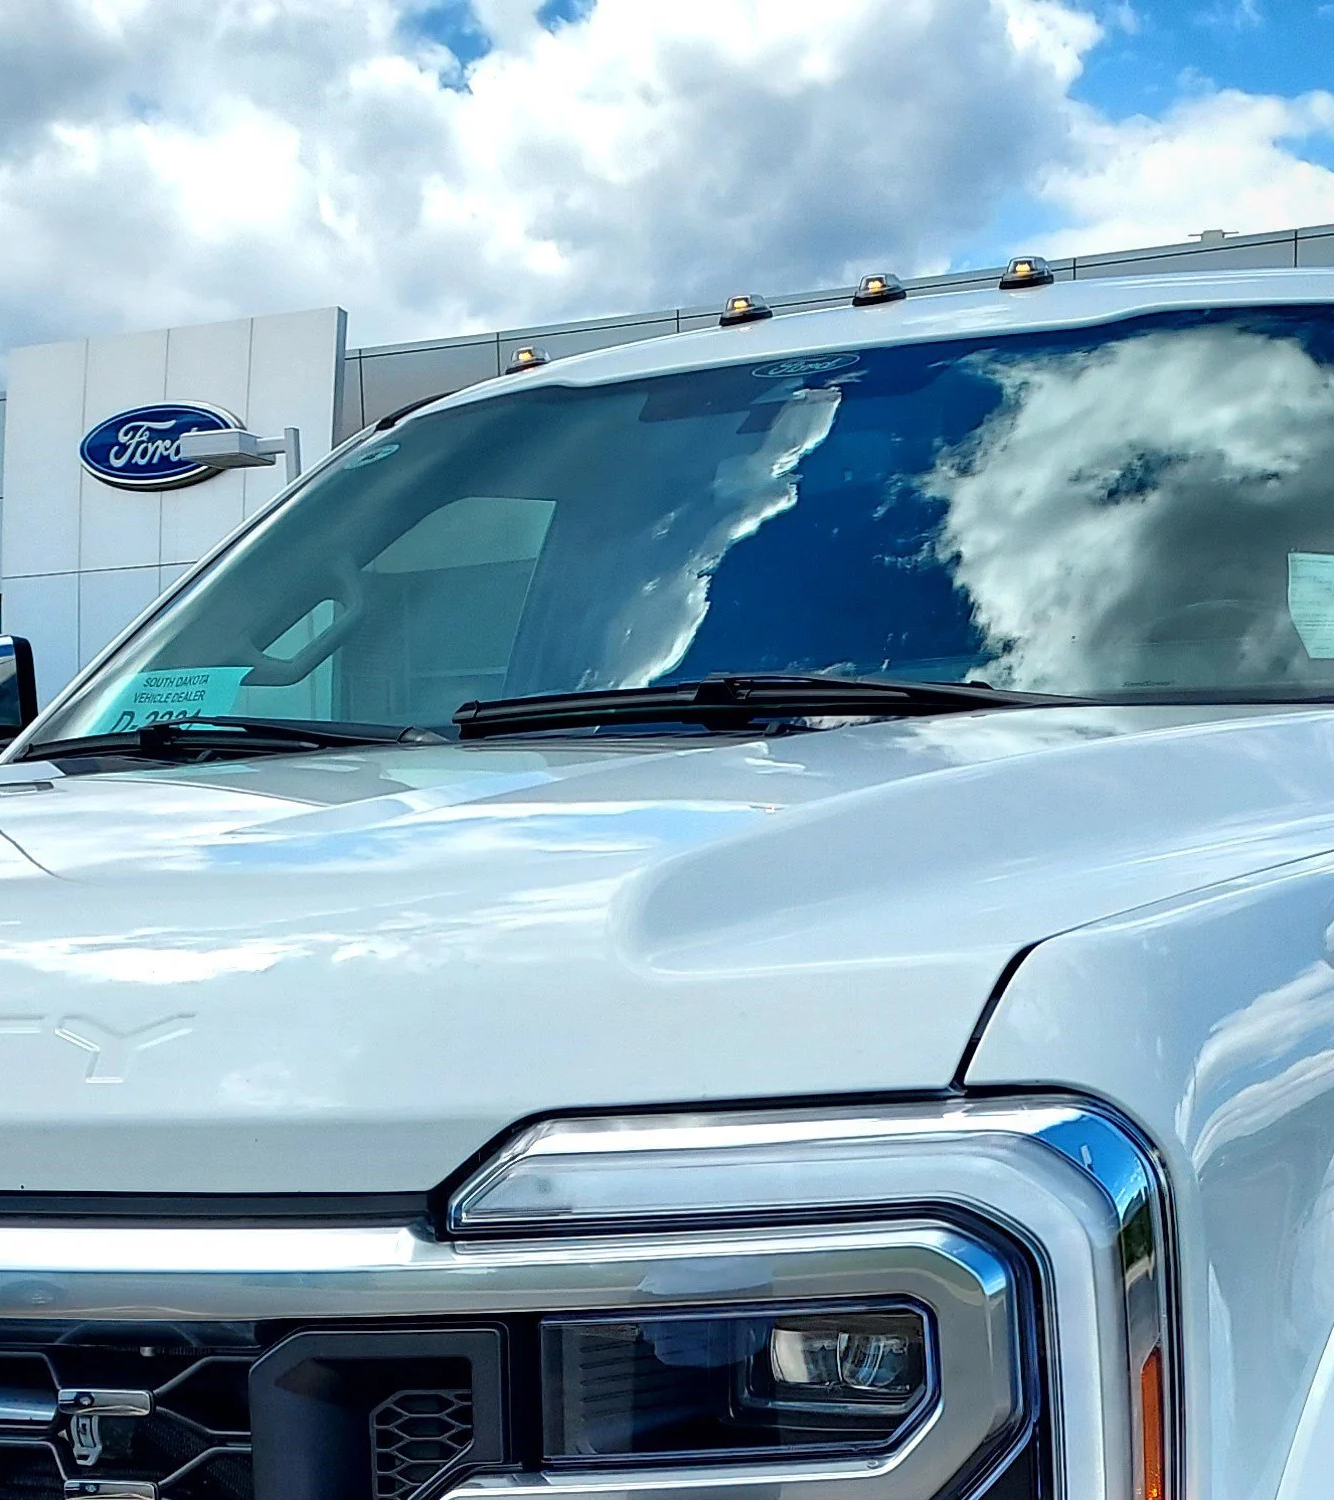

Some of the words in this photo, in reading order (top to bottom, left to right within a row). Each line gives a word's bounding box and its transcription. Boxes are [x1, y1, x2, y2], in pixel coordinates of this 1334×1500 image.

[768, 356, 843, 376] Ford
[143, 676, 174, 688] SOUTH
[175, 674, 210, 687] DAKOTA
[133, 692, 172, 704] VEHICLE
[171, 690, 206, 703] DEALER
